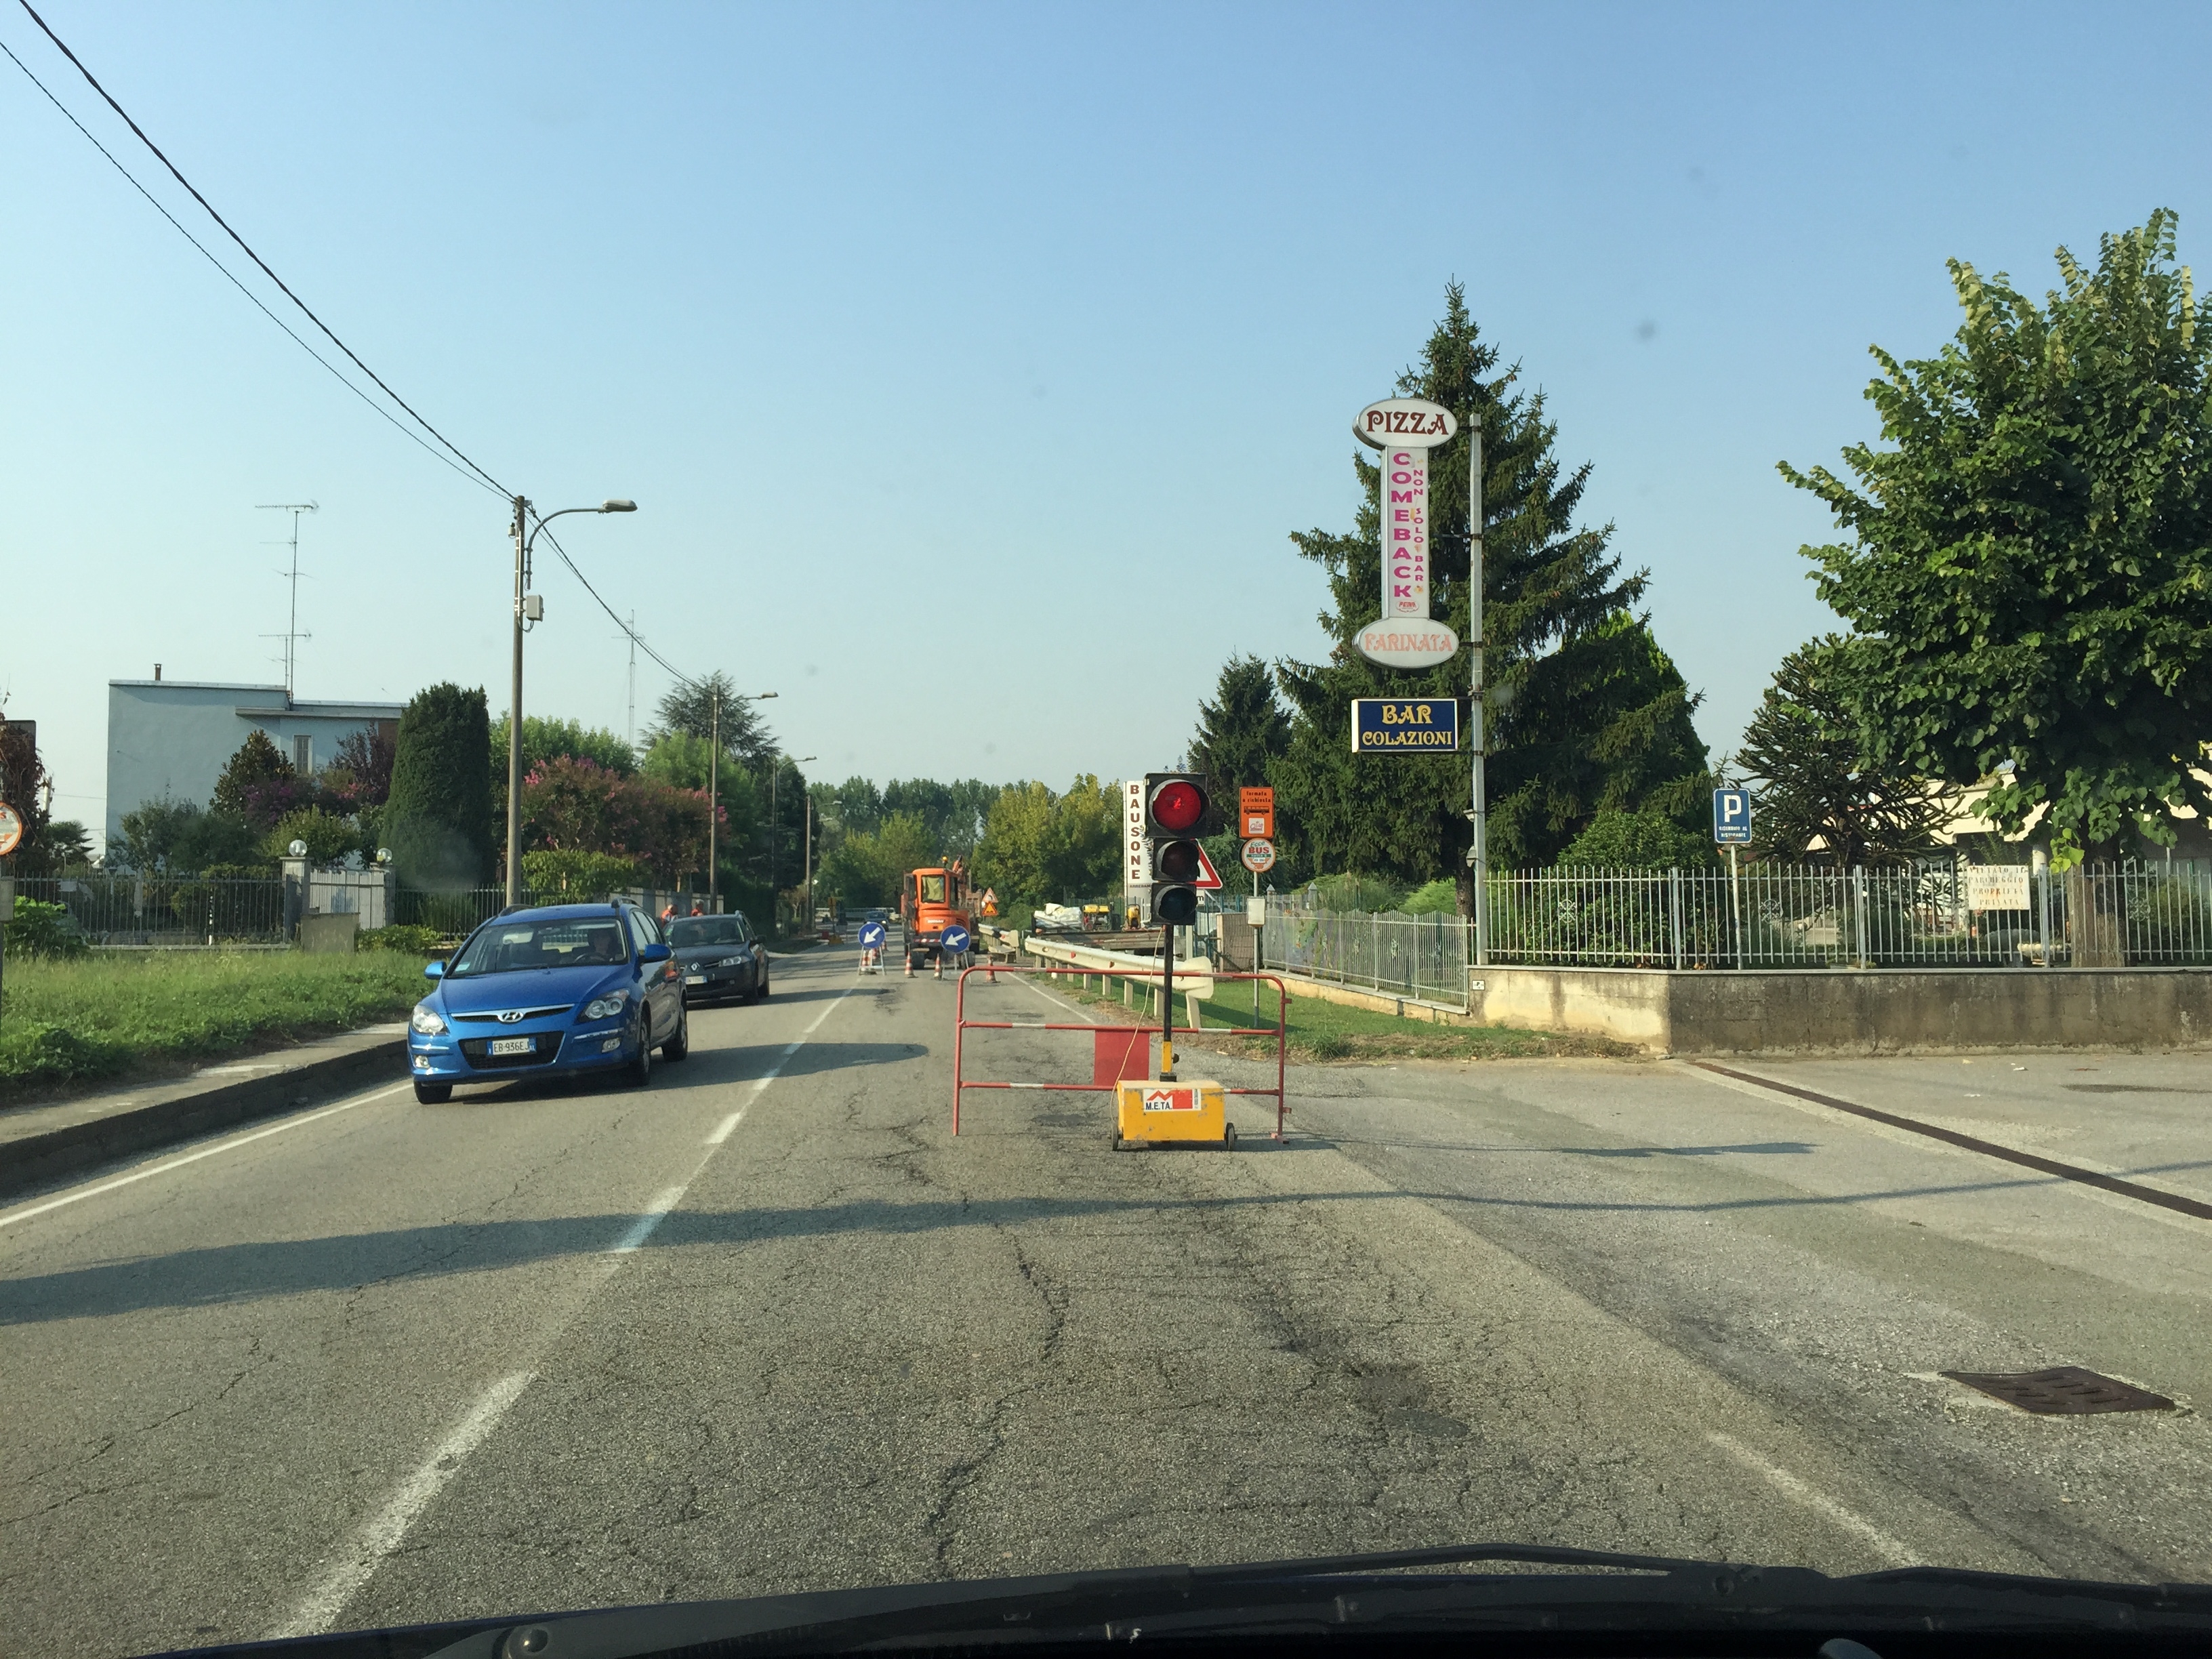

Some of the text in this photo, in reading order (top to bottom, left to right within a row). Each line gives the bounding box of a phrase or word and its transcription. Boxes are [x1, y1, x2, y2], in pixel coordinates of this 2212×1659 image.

[1366, 410, 1448, 435] PIZZA
[1391, 453, 1413, 597] COMEBACK
[1413, 470, 1424, 581] NON SOLO BAR
[1364, 633, 1453, 651] FARINATA
[1382, 705, 1433, 724] BAR
[1362, 731, 1452, 745] COLAZIONI
[1724, 795, 1742, 823] P
[1130, 785, 1141, 880] BAUSONE
